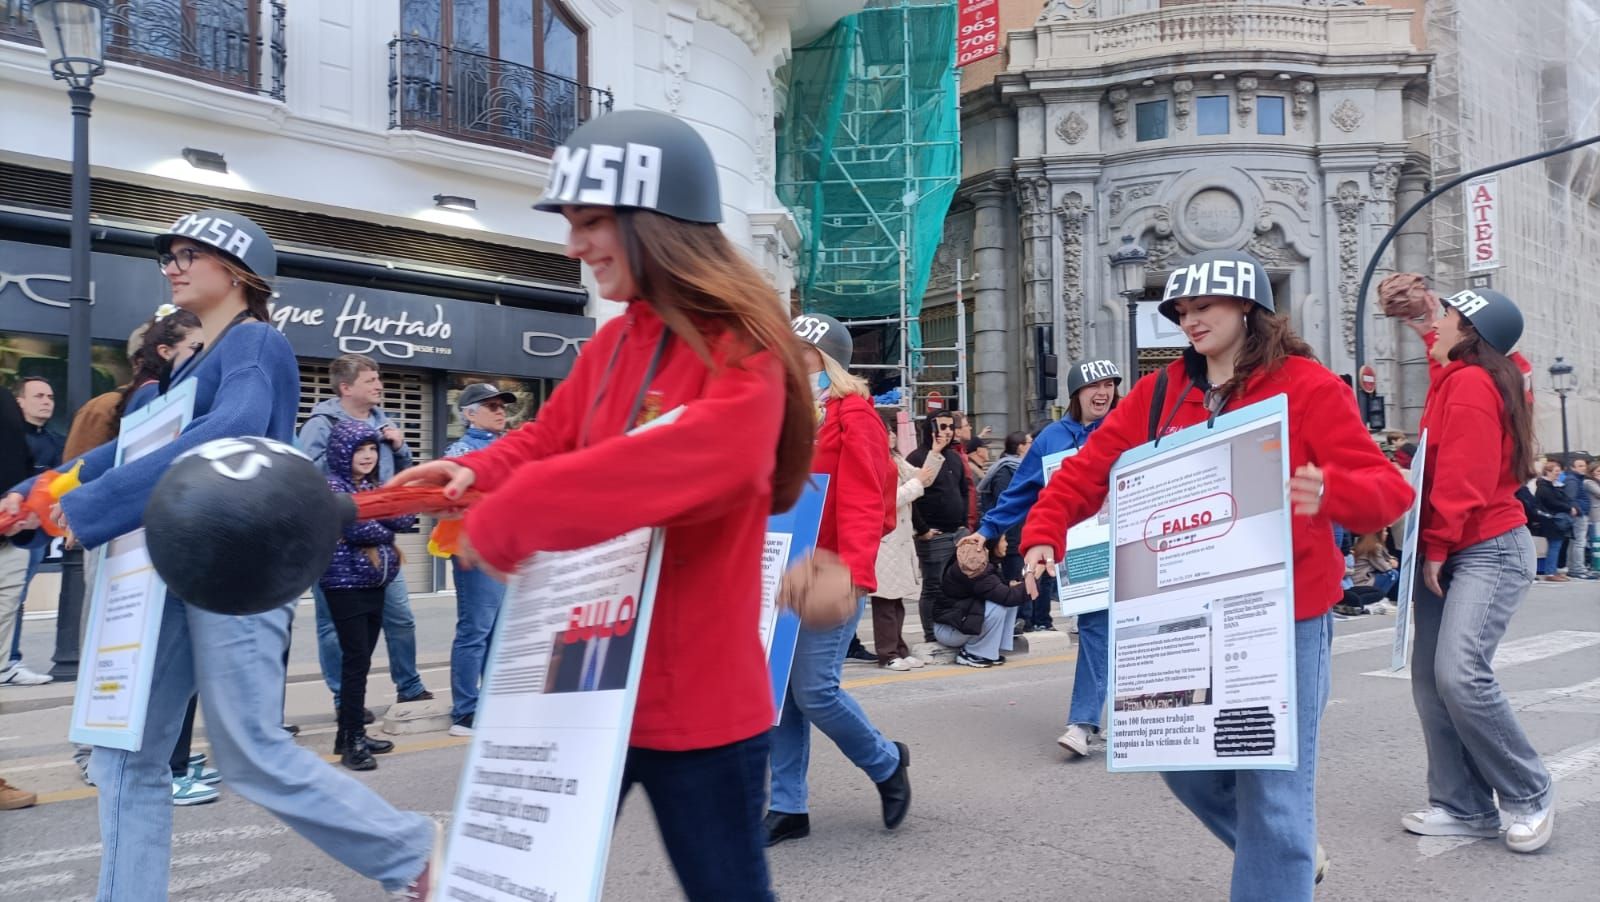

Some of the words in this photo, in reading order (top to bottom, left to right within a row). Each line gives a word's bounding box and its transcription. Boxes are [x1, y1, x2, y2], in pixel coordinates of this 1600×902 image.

[961, 16, 996, 36] 963
[960, 31, 996, 50] 706
[1472, 185, 1493, 261] ATES
[333, 294, 452, 339] Hurtado
[1162, 510, 1213, 537] FALSO
[1129, 717, 1139, 726] 100
[1140, 716, 1165, 725] forenses
[1166, 713, 1195, 724] trabajan
[1149, 729, 1163, 737] para
[1165, 725, 1195, 736] practicar
[1196, 724, 1206, 733] las
[1145, 738, 1154, 747] las
[1183, 736, 1191, 745] de
[1193, 736, 1200, 744] la
